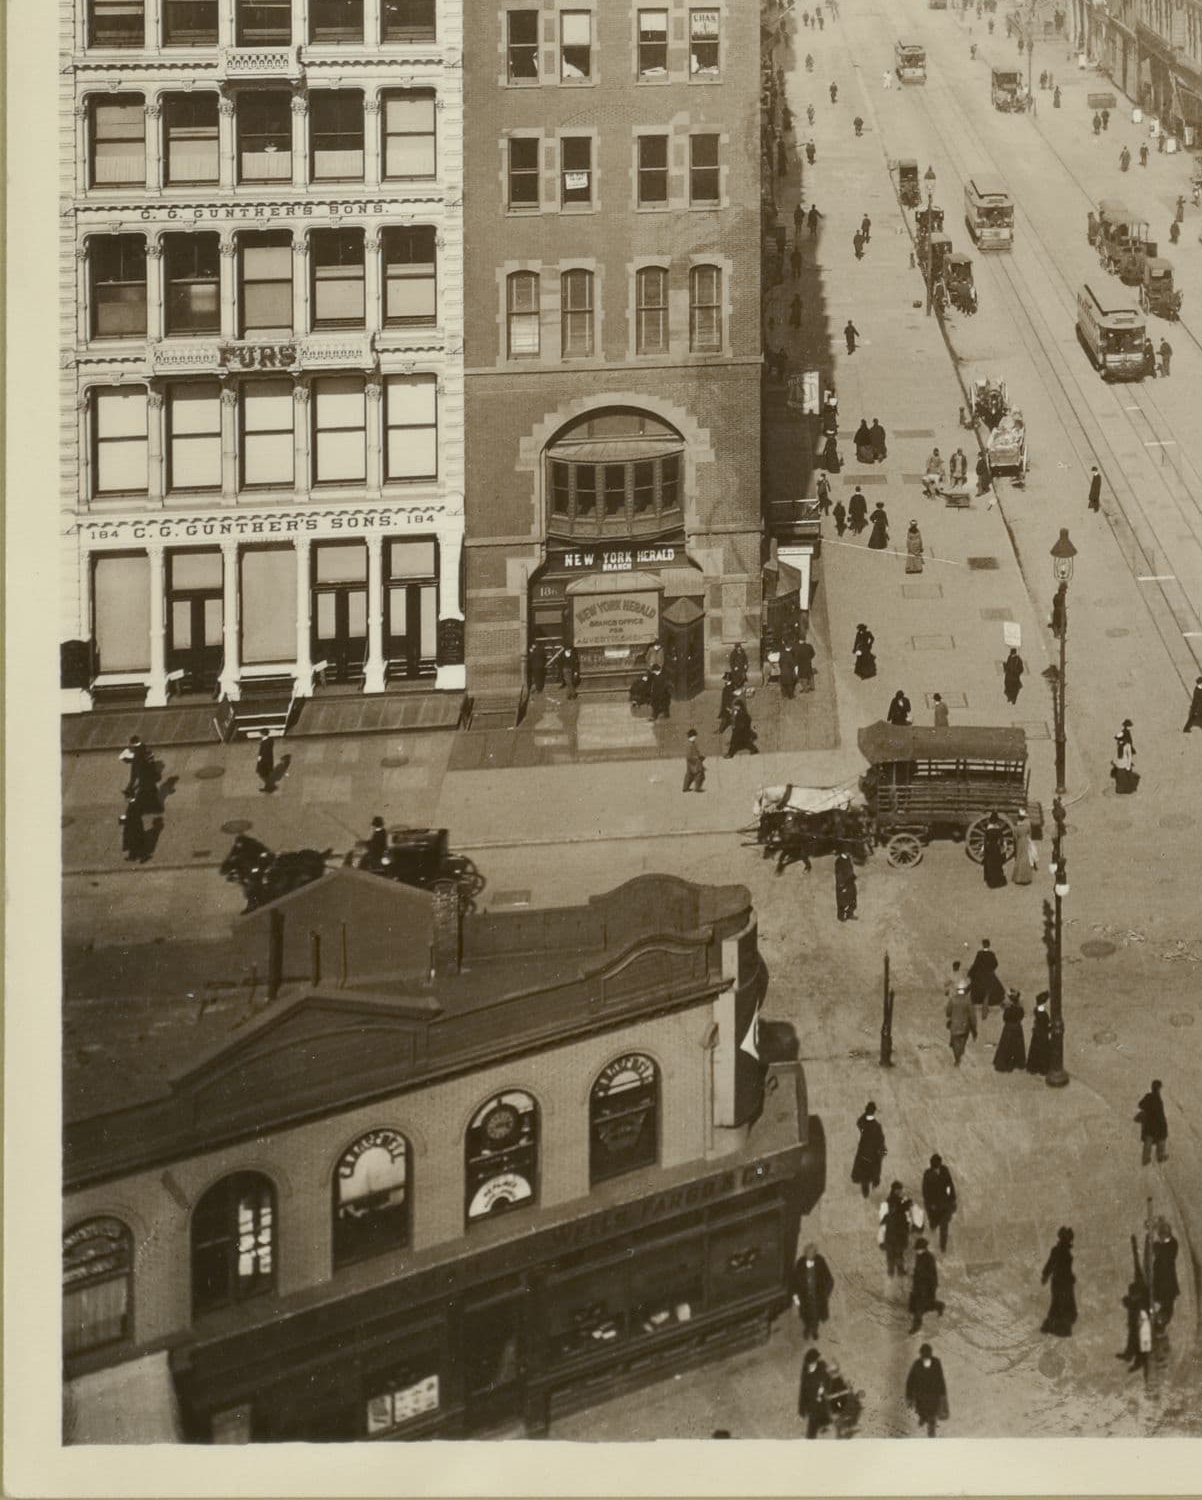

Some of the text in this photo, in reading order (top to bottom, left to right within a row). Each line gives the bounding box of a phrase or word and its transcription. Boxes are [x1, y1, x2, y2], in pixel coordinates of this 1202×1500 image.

[194, 206, 313, 219] GUNTHER'S
[329, 204, 389, 215] SONS.
[217, 346, 297, 368] FURS
[91, 529, 119, 540] 184
[186, 518, 318, 536] GUNTHER'S
[331, 515, 398, 530] SONS.
[406, 514, 435, 525] 184
[564, 548, 675, 567] NEW YORK HERALD
[602, 563, 632, 571] BRANCH
[575, 600, 656, 624] NEW YORK HERALD
[589, 618, 644, 627] BRANCH OFFICE
